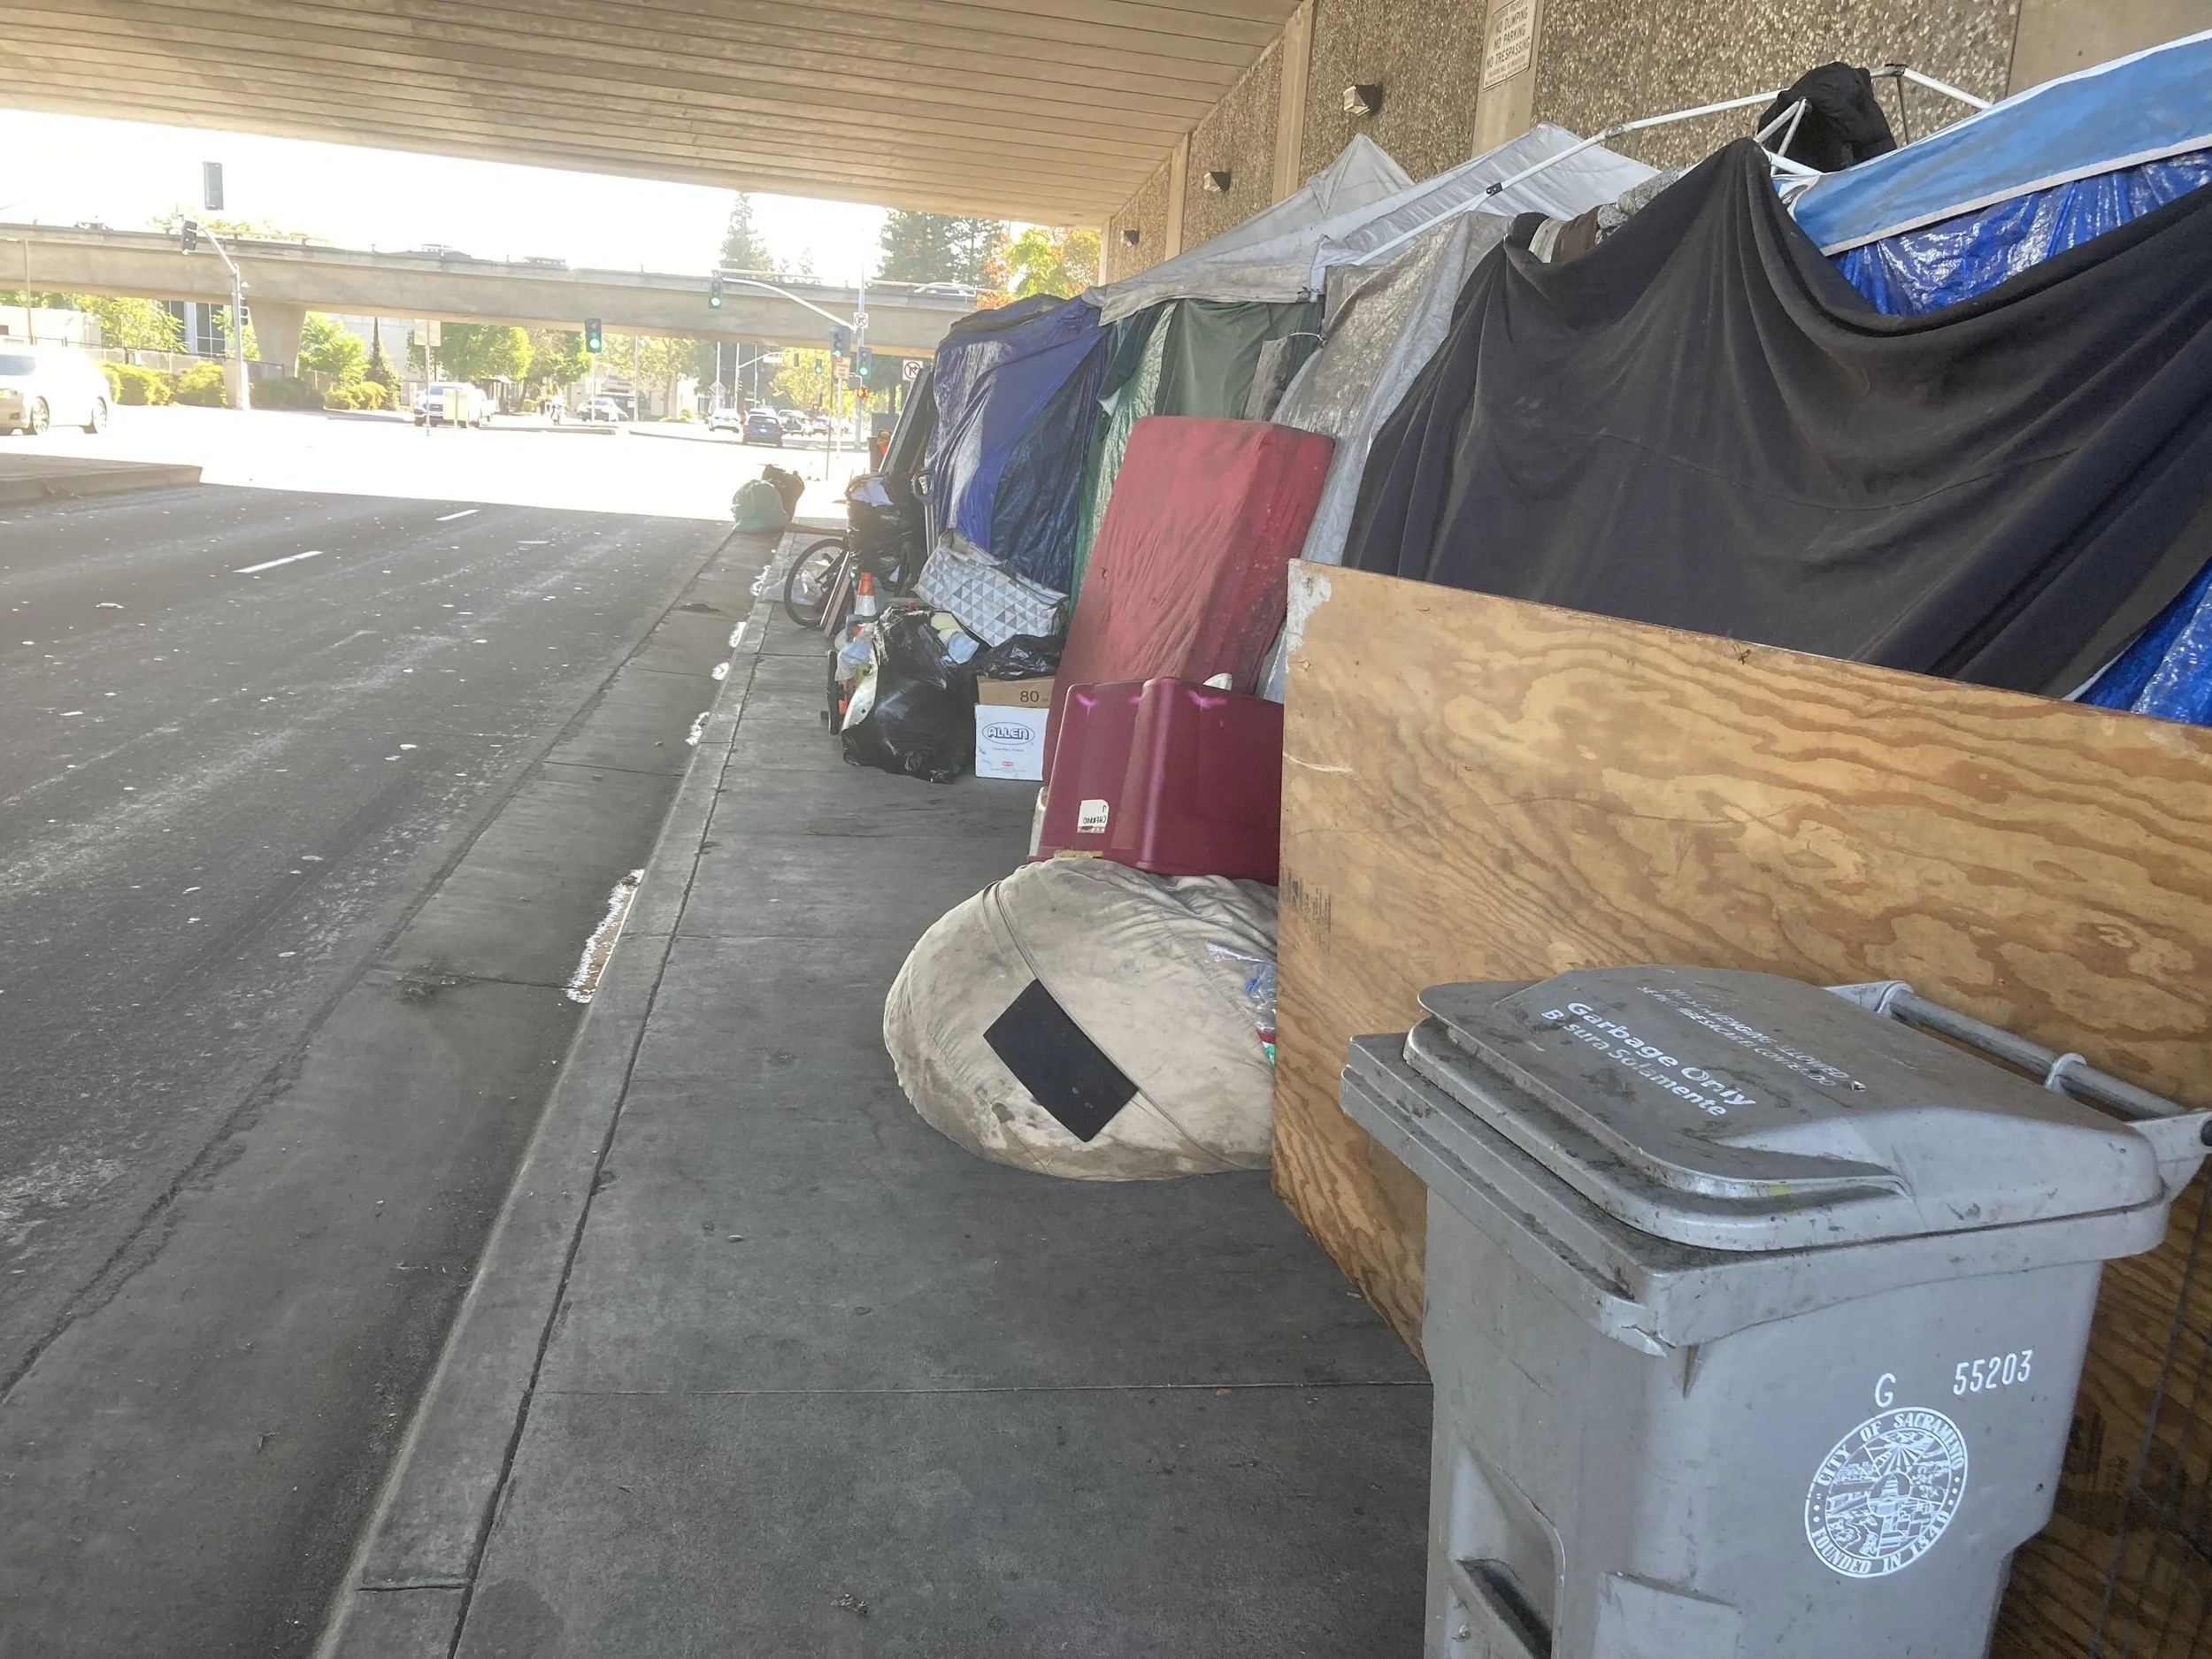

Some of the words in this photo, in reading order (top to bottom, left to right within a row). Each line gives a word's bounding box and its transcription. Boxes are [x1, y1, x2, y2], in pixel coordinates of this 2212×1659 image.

[1494, 36, 1502, 50] NO
[1502, 24, 1526, 46] PARKING
[1495, 20, 1502, 34] NO
[1504, 6, 1528, 31] DUMPING
[1486, 56, 1494, 69] NO
[1495, 36, 1531, 65] TRESPASSING
[1020, 690, 1040, 703] 80
[987, 726, 1030, 741] ALLEN
[1540, 1008, 1609, 1051] Bsura
[1567, 1002, 1678, 1067] Garbage
[1681, 1066, 1756, 1106] Only
[1753, 1047, 1838, 1087] CONTENDO
[1873, 1372, 1897, 1408] G
[1952, 1348, 2033, 1396] 55203
[1816, 1444, 1851, 1487] CITY
[1859, 1420, 1883, 1443] OF
[1893, 1411, 1965, 1471] SACRAMENTO
[1811, 1528, 1872, 1574] FOUNDED
[1881, 1555, 1904, 1573] IN
